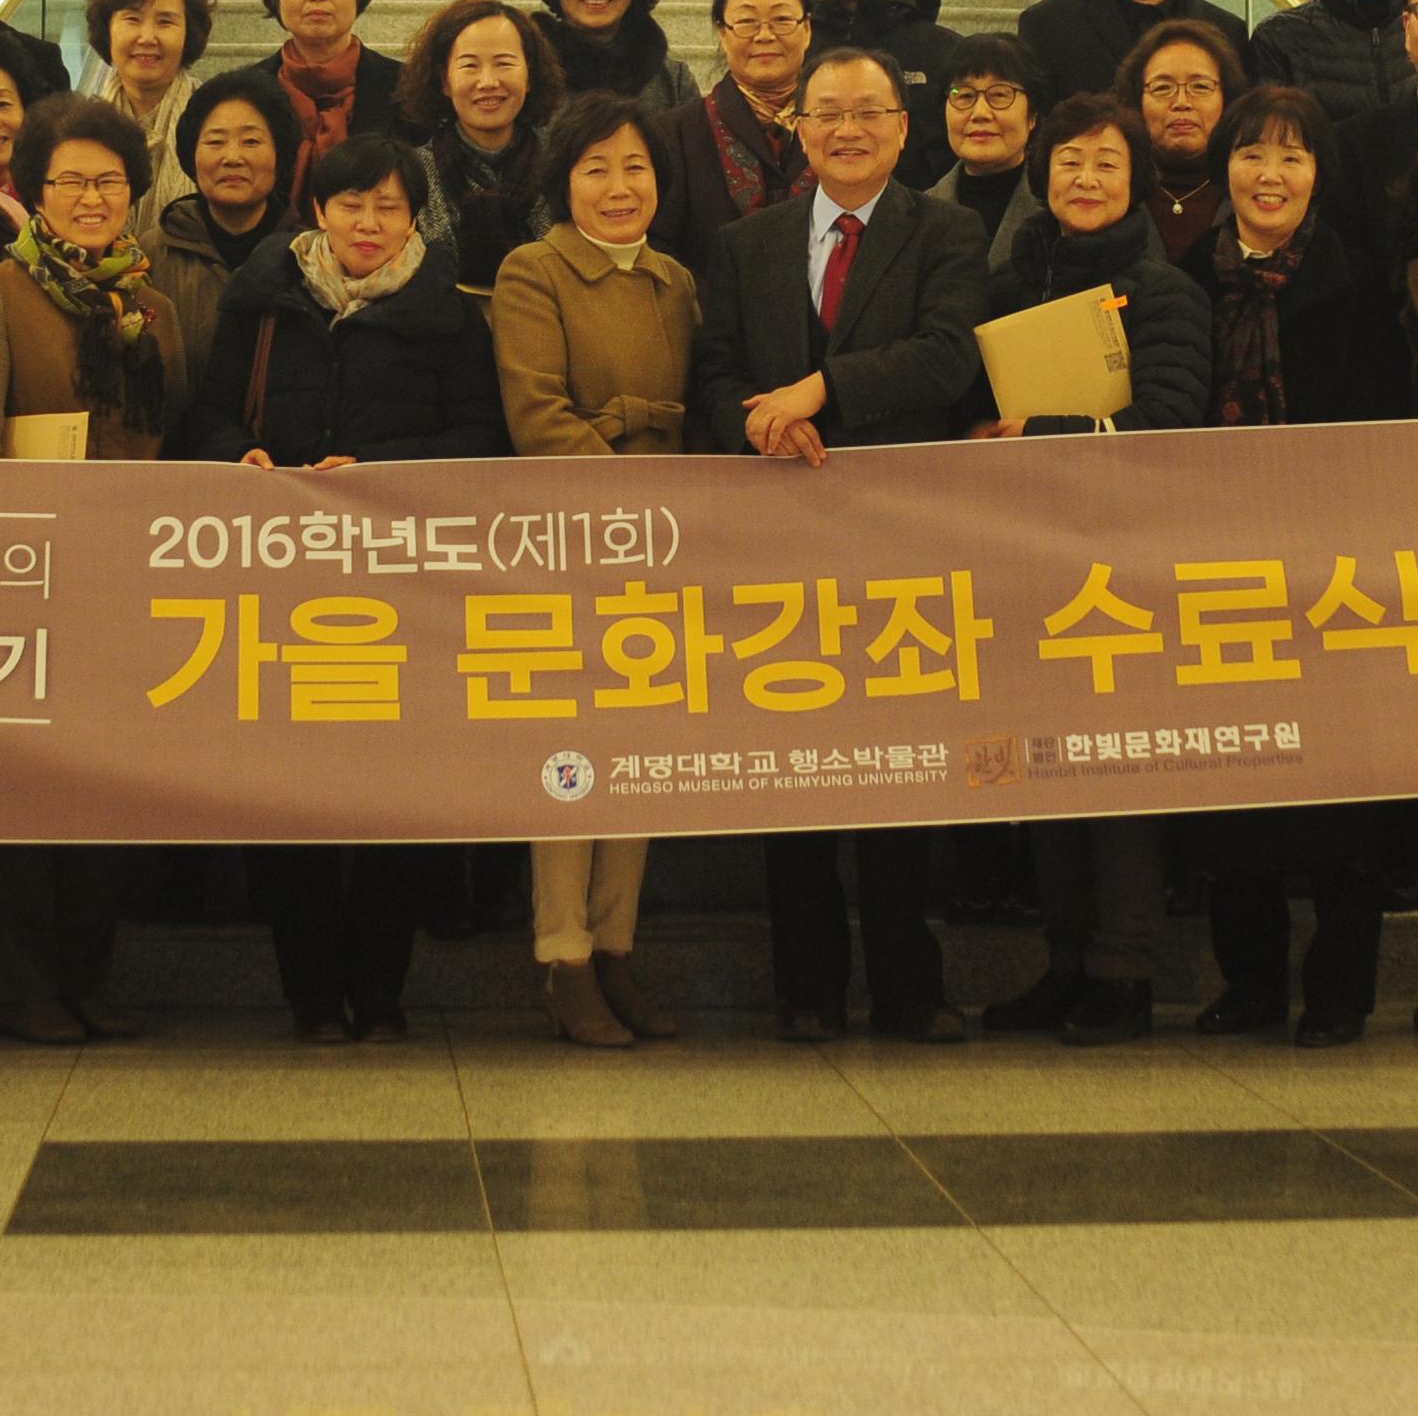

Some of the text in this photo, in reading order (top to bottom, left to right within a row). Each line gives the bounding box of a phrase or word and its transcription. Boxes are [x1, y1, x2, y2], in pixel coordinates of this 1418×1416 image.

[145, 592, 409, 722] 가을
[456, 570, 994, 720] 문화강좌
[609, 750, 780, 781] 계명대학교
[788, 743, 950, 774] 행소박물관
[1065, 721, 1302, 763] 한빛문화재연구원
[609, 769, 949, 795] HENGSO MUSEUM OF KEIMYUNG UNIVERSITY
